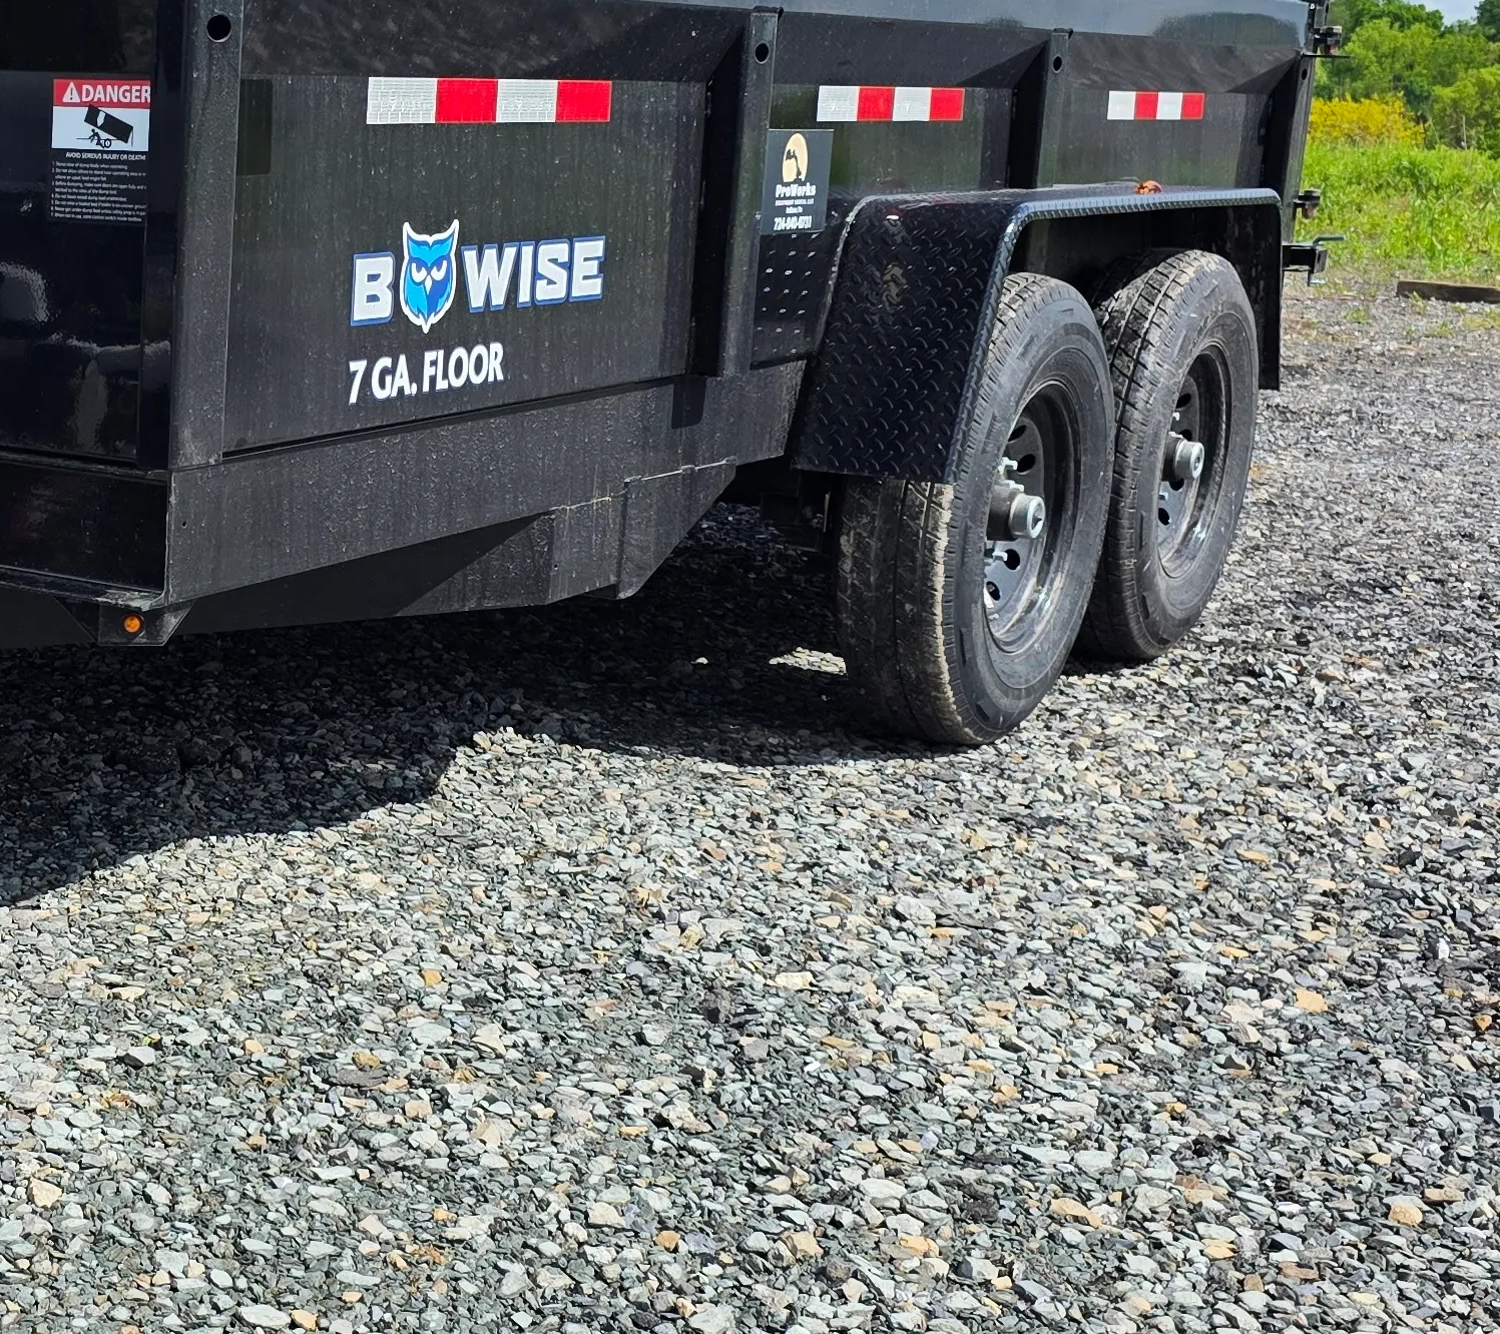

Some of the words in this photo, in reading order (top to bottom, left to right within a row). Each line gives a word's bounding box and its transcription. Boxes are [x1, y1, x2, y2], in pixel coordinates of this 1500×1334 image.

[81, 84, 151, 103] DANGER
[775, 182, 816, 198] ProWorks
[349, 359, 367, 405] 7
[371, 353, 418, 400] GA.
[422, 341, 504, 393] FLOOR
